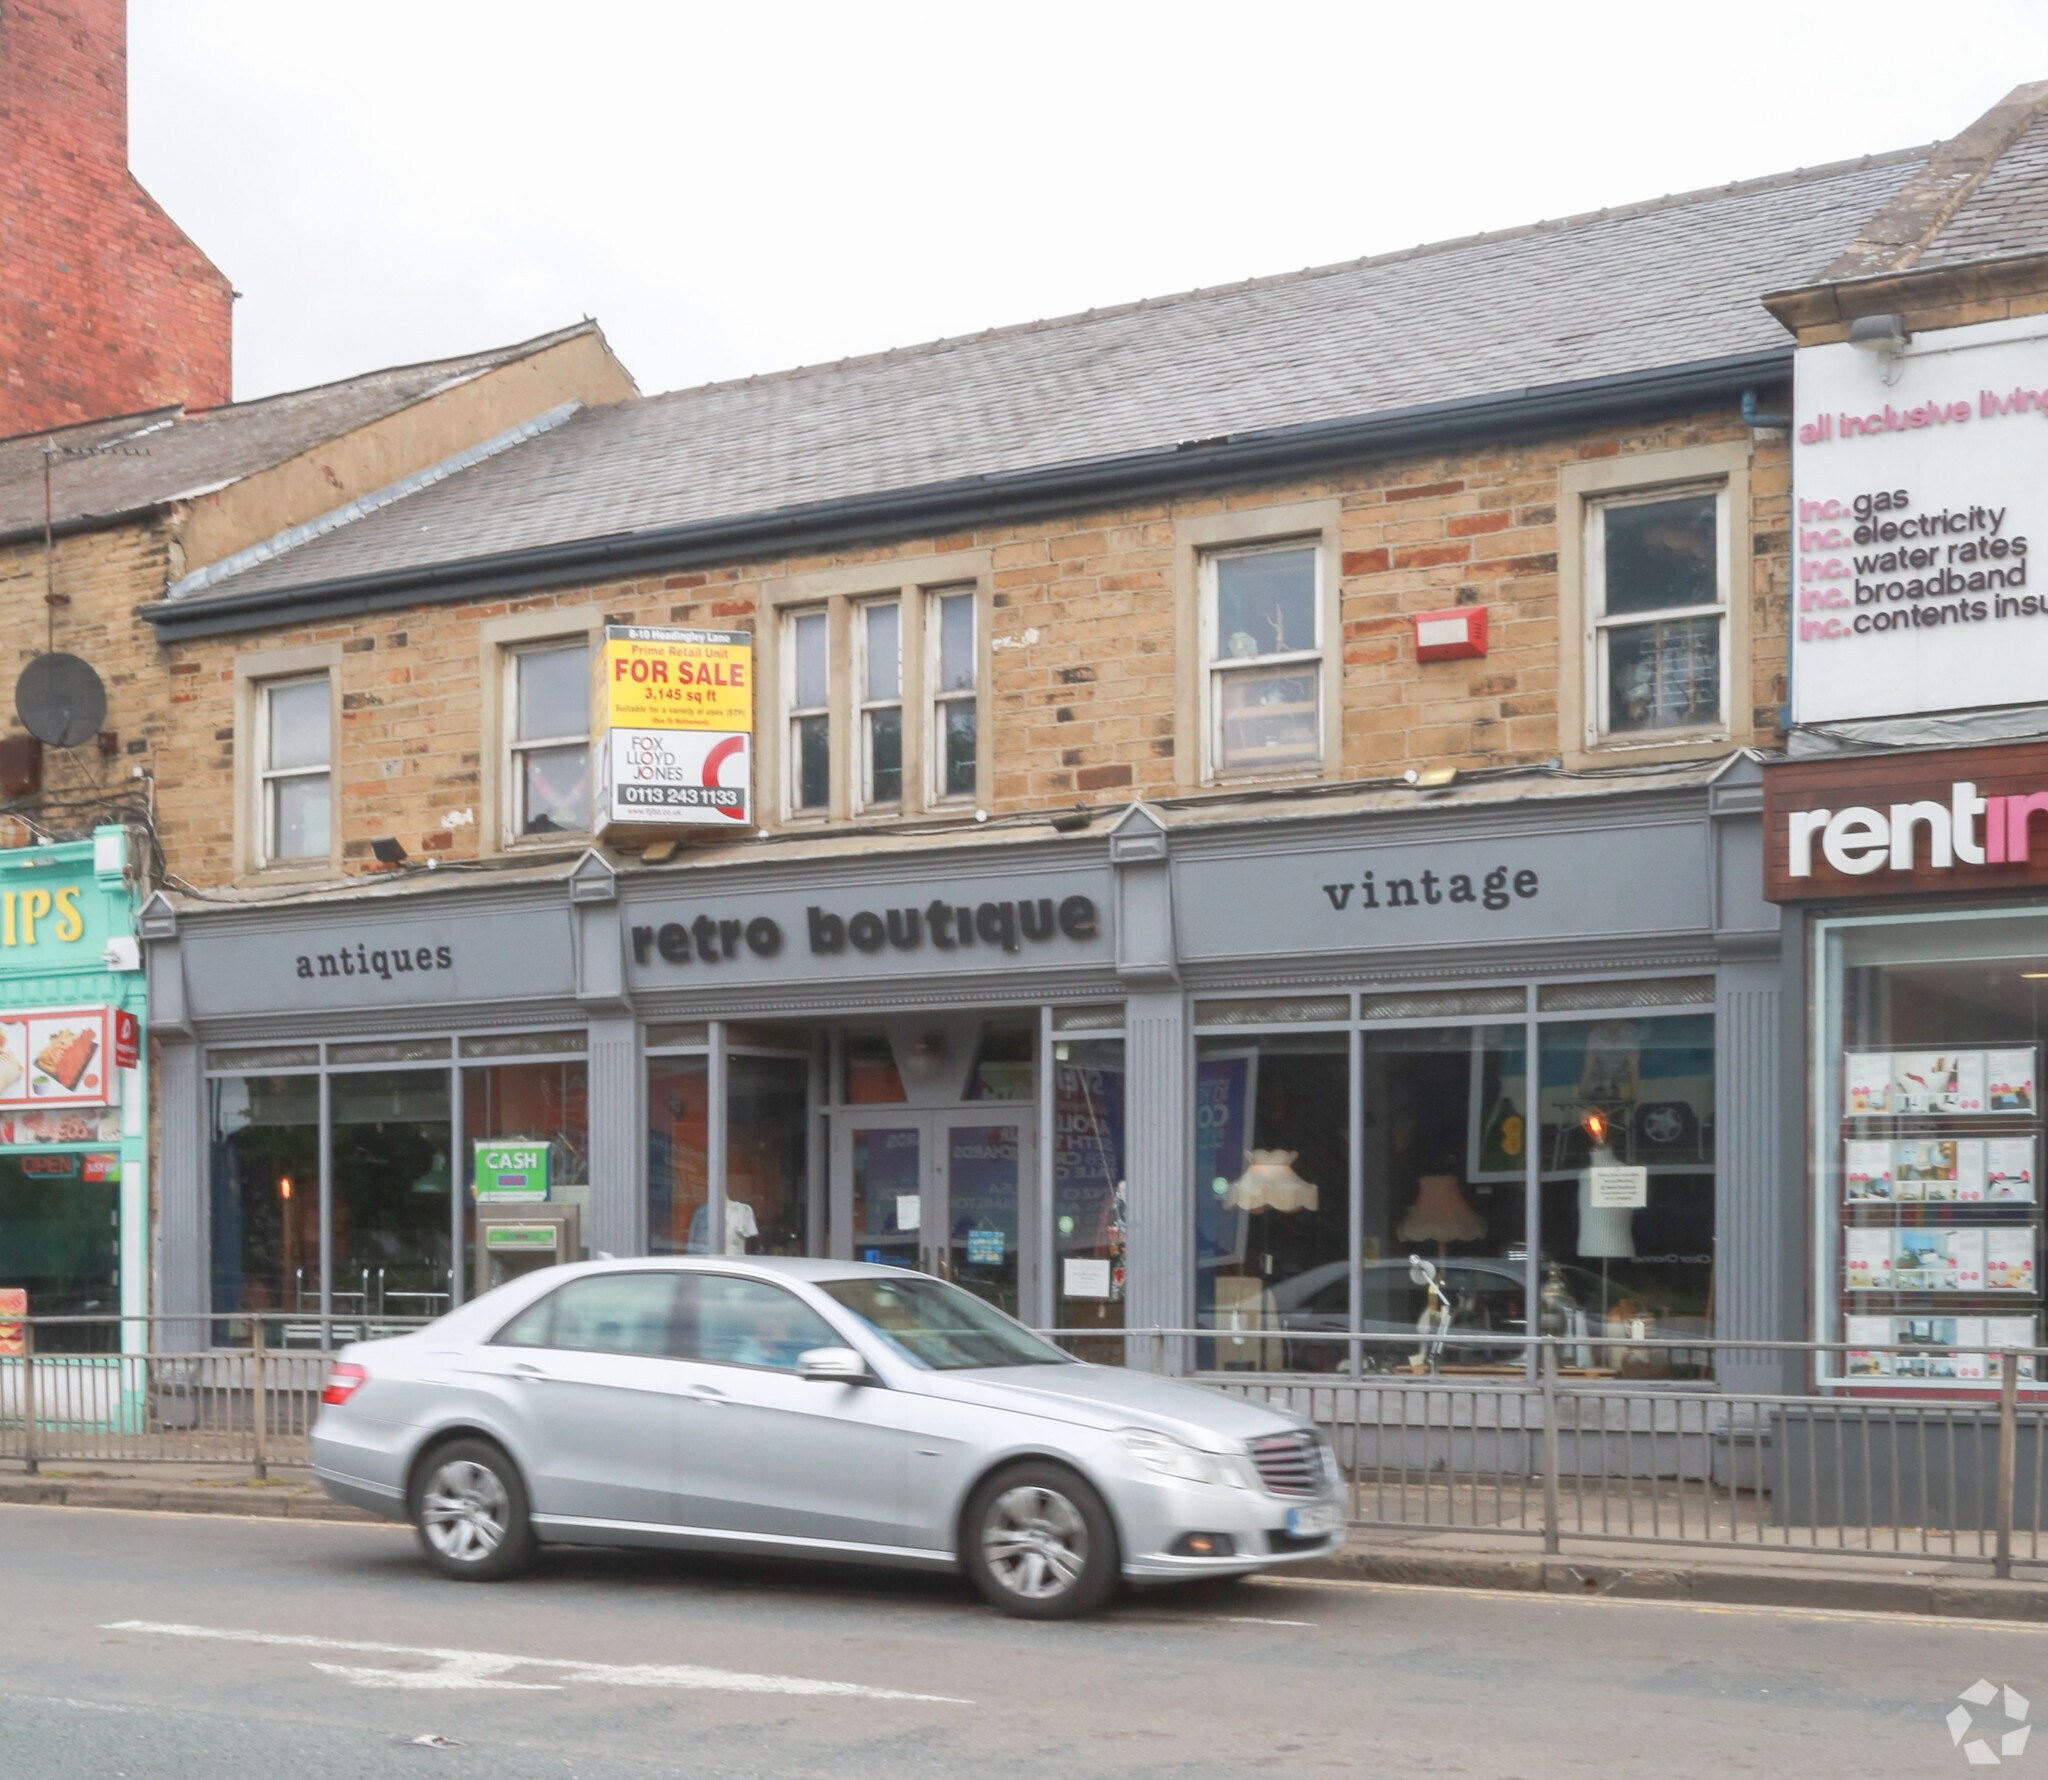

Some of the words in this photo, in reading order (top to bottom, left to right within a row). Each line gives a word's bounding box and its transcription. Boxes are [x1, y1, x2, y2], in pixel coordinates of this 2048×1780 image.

[1799, 413, 1831, 445] all
[1839, 399, 1971, 438] inclusive
[1799, 497, 1851, 523] inc.
[1853, 488, 1909, 522] gas
[1799, 525, 1851, 552] inc.
[1853, 504, 2006, 546] electricity
[1799, 556, 1851, 582] inc.
[1853, 545, 1940, 575] water
[1948, 535, 2028, 564] rates
[1799, 586, 1851, 612] inc.
[1855, 557, 2026, 606] broadband
[1799, 616, 1852, 642] inc.
[1853, 598, 1988, 634] contents
[707, 633, 731, 643] Lane
[631, 645, 665, 656] Prime
[669, 647, 702, 658] Retail
[705, 648, 729, 659] Unit
[615, 659, 668, 683] FOR
[679, 661, 745, 687] SALE
[645, 688, 681, 702] 3,145
[687, 690, 702, 704] sq
[706, 690, 717, 702] ft
[615, 704, 647, 714] Suitable
[650, 706, 659, 714] for
[669, 707, 695, 716] variety
[697, 707, 705, 715] of
[706, 709, 724, 717] uses
[631, 736, 664, 751] FOX
[626, 752, 676, 766] LLOYD
[633, 766, 684, 781] JONES
[625, 786, 664, 803] 0113
[667, 788, 699, 804] 243
[701, 790, 738, 806] 1133
[1322, 865, 1539, 911] vintage
[631, 913, 782, 965] retro
[807, 894, 1098, 955] boutique
[296, 943, 453, 980] antiques
[22, 1156, 72, 1174] OPEN
[486, 1152, 538, 1169] CASH
